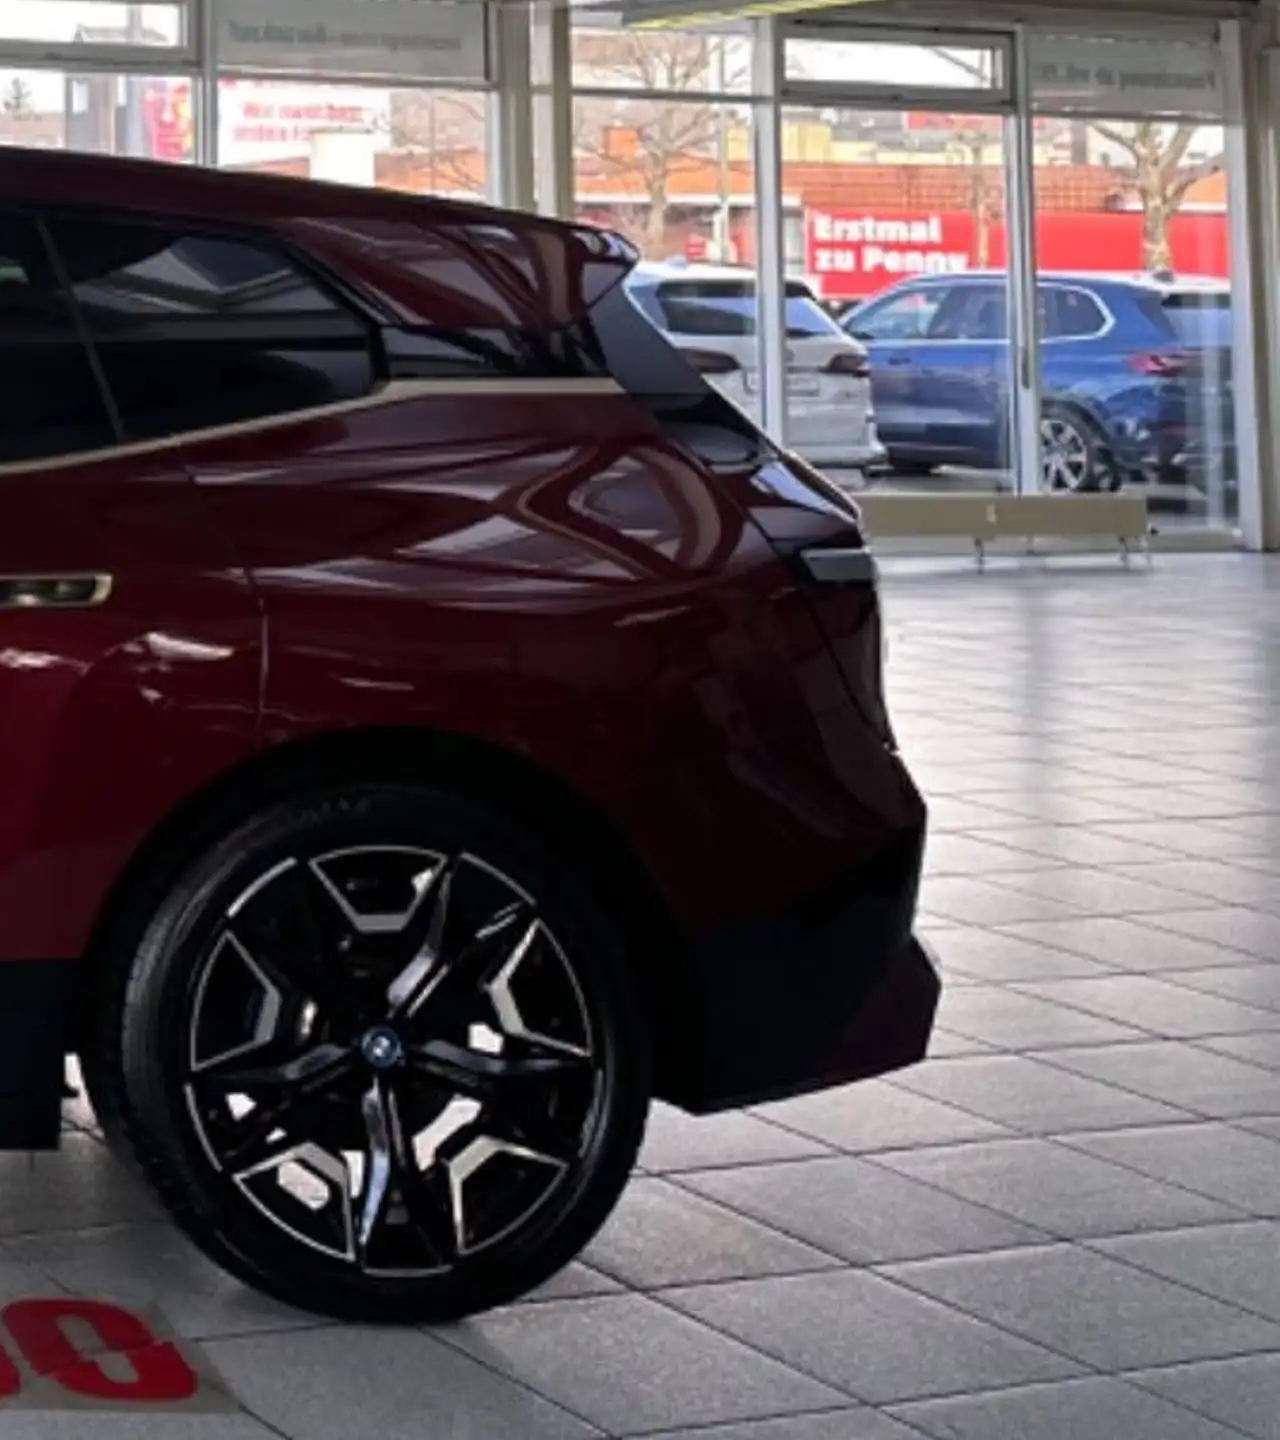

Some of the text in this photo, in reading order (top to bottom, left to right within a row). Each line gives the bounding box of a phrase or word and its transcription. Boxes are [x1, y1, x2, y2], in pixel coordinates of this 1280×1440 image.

[813, 216, 943, 243] Erstmal
[814, 245, 969, 275] zu Penny
